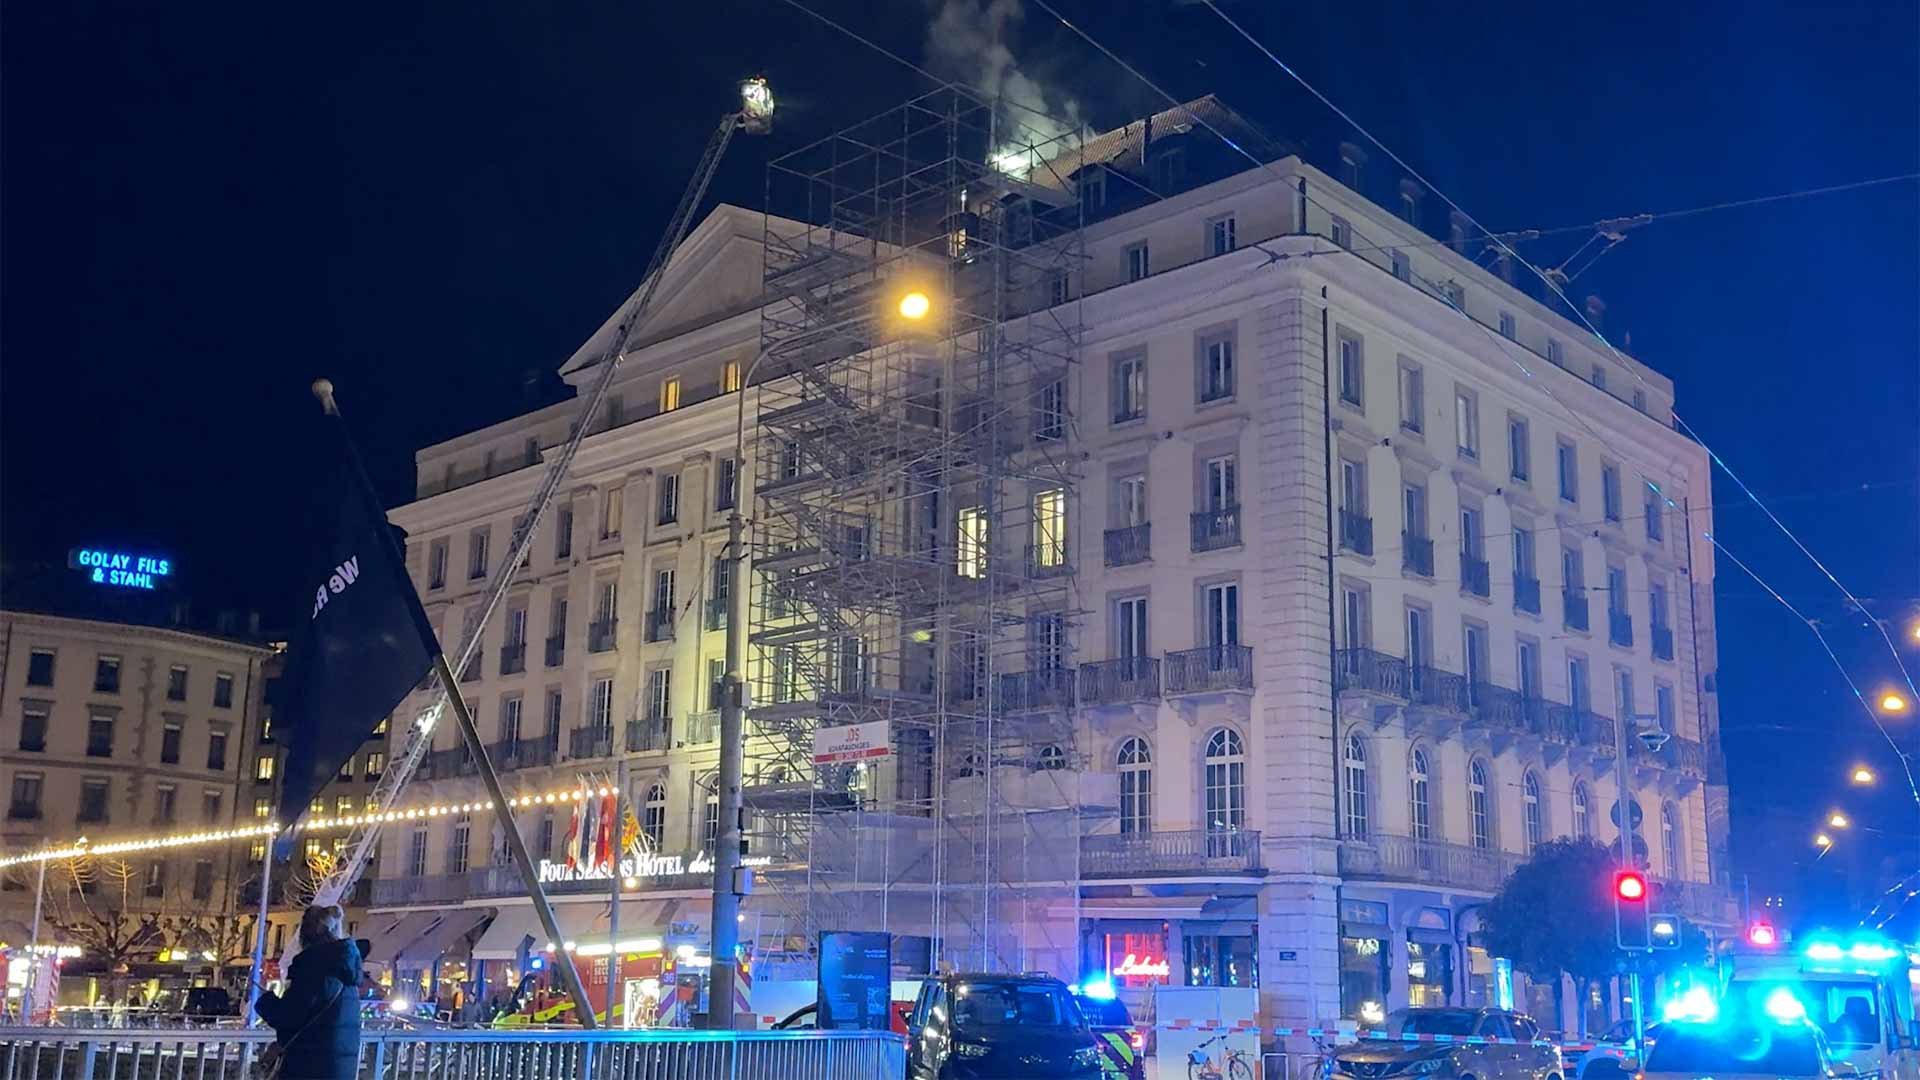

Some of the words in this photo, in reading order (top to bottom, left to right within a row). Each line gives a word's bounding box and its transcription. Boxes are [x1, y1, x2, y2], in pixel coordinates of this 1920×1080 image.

[80, 550, 130, 569] GOLAY
[138, 557, 168, 575] FILS
[93, 567, 104, 583] &
[110, 569, 153, 589] STAHL
